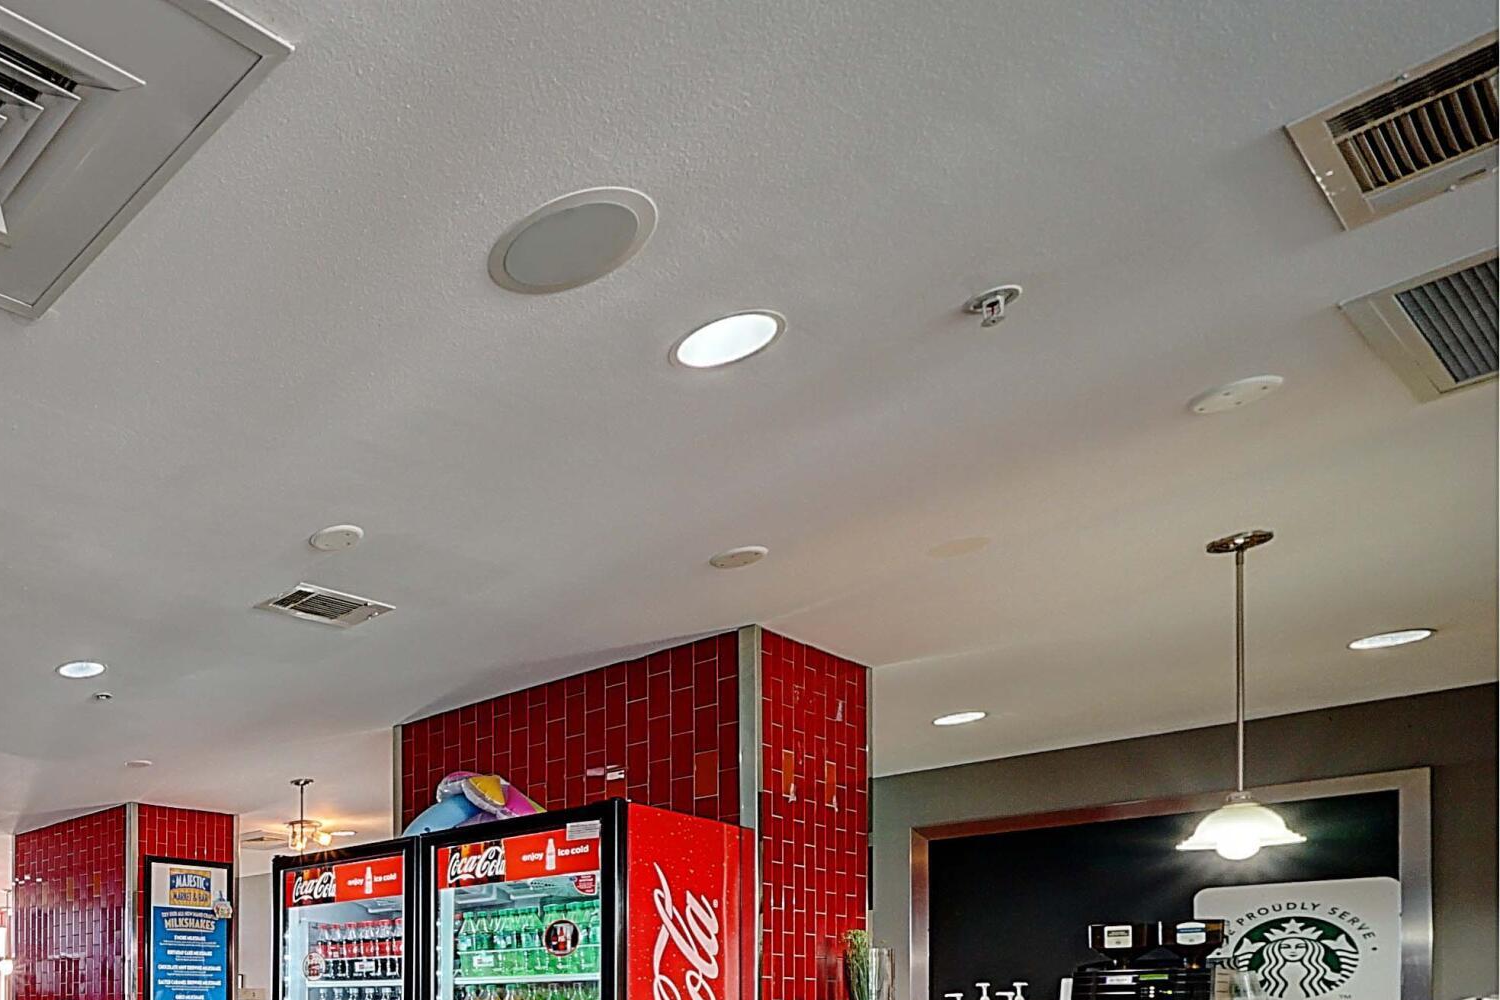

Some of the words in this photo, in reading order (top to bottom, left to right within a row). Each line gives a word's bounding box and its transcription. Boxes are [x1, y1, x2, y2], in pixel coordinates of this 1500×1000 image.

[521, 853, 544, 862] enjoy
[557, 848, 570, 857] ice
[571, 845, 589, 854] cold
[175, 874, 206, 890] MAJESTIC
[347, 878, 364, 886] enjoy
[164, 918, 216, 930] MILKSHAKES
[1236, 902, 1321, 926] PROUDLY
[1328, 906, 1376, 940] SERVE
